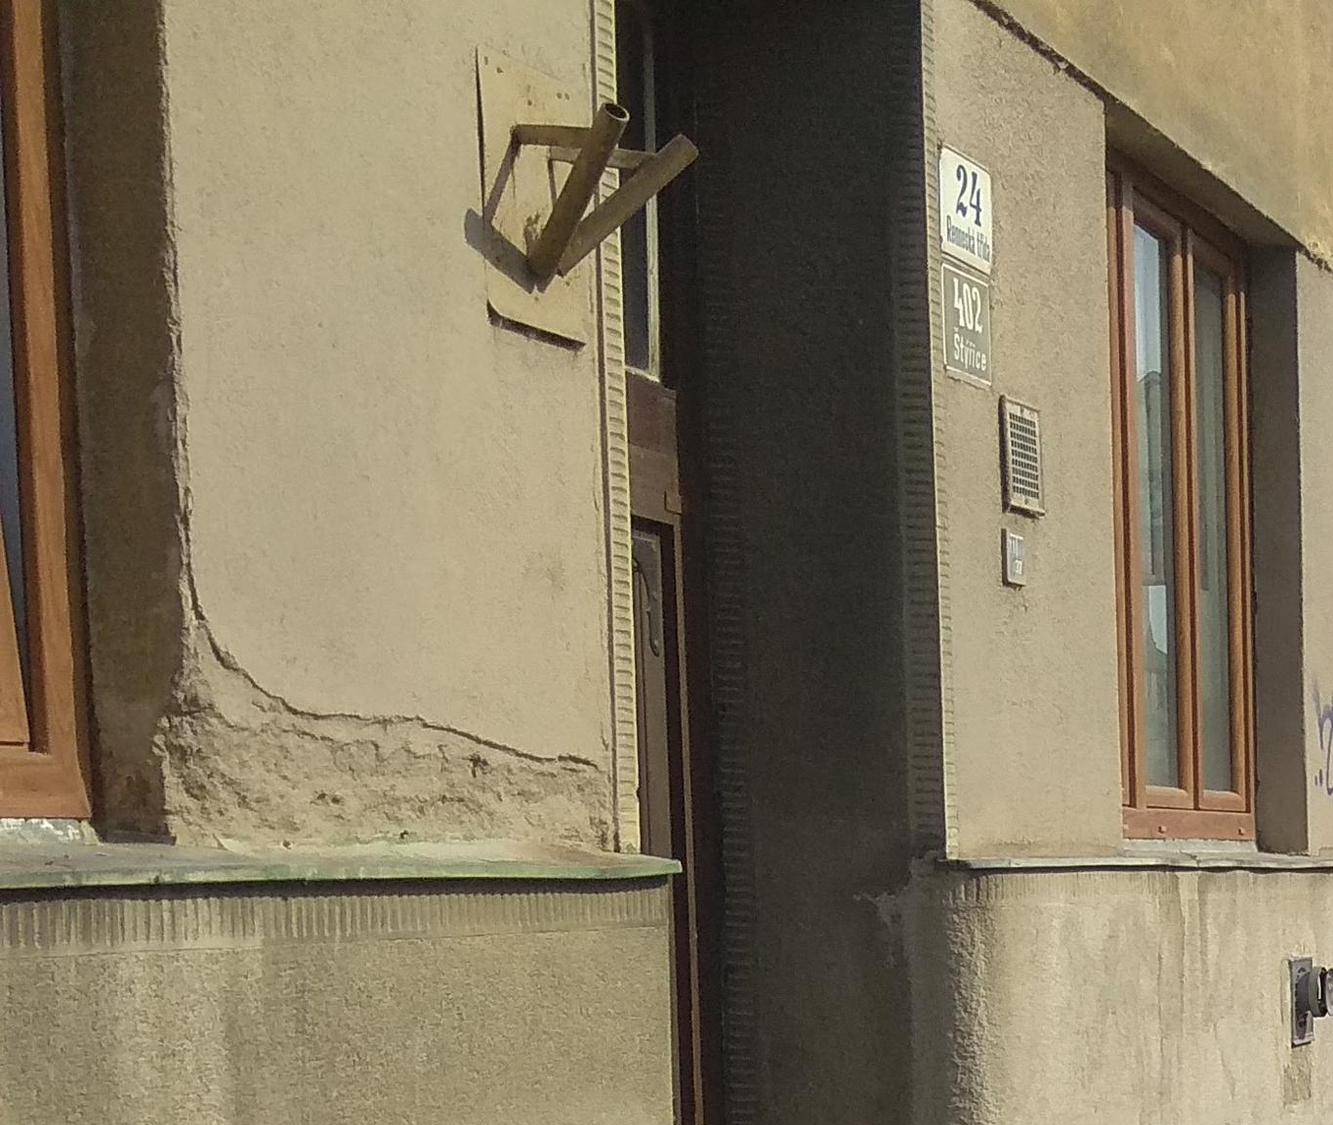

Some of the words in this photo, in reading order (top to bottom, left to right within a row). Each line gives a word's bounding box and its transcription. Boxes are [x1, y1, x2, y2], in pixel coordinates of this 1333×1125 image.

[955, 164, 982, 227] 24
[953, 277, 983, 333] 402
[953, 326, 987, 371] Štýřice
